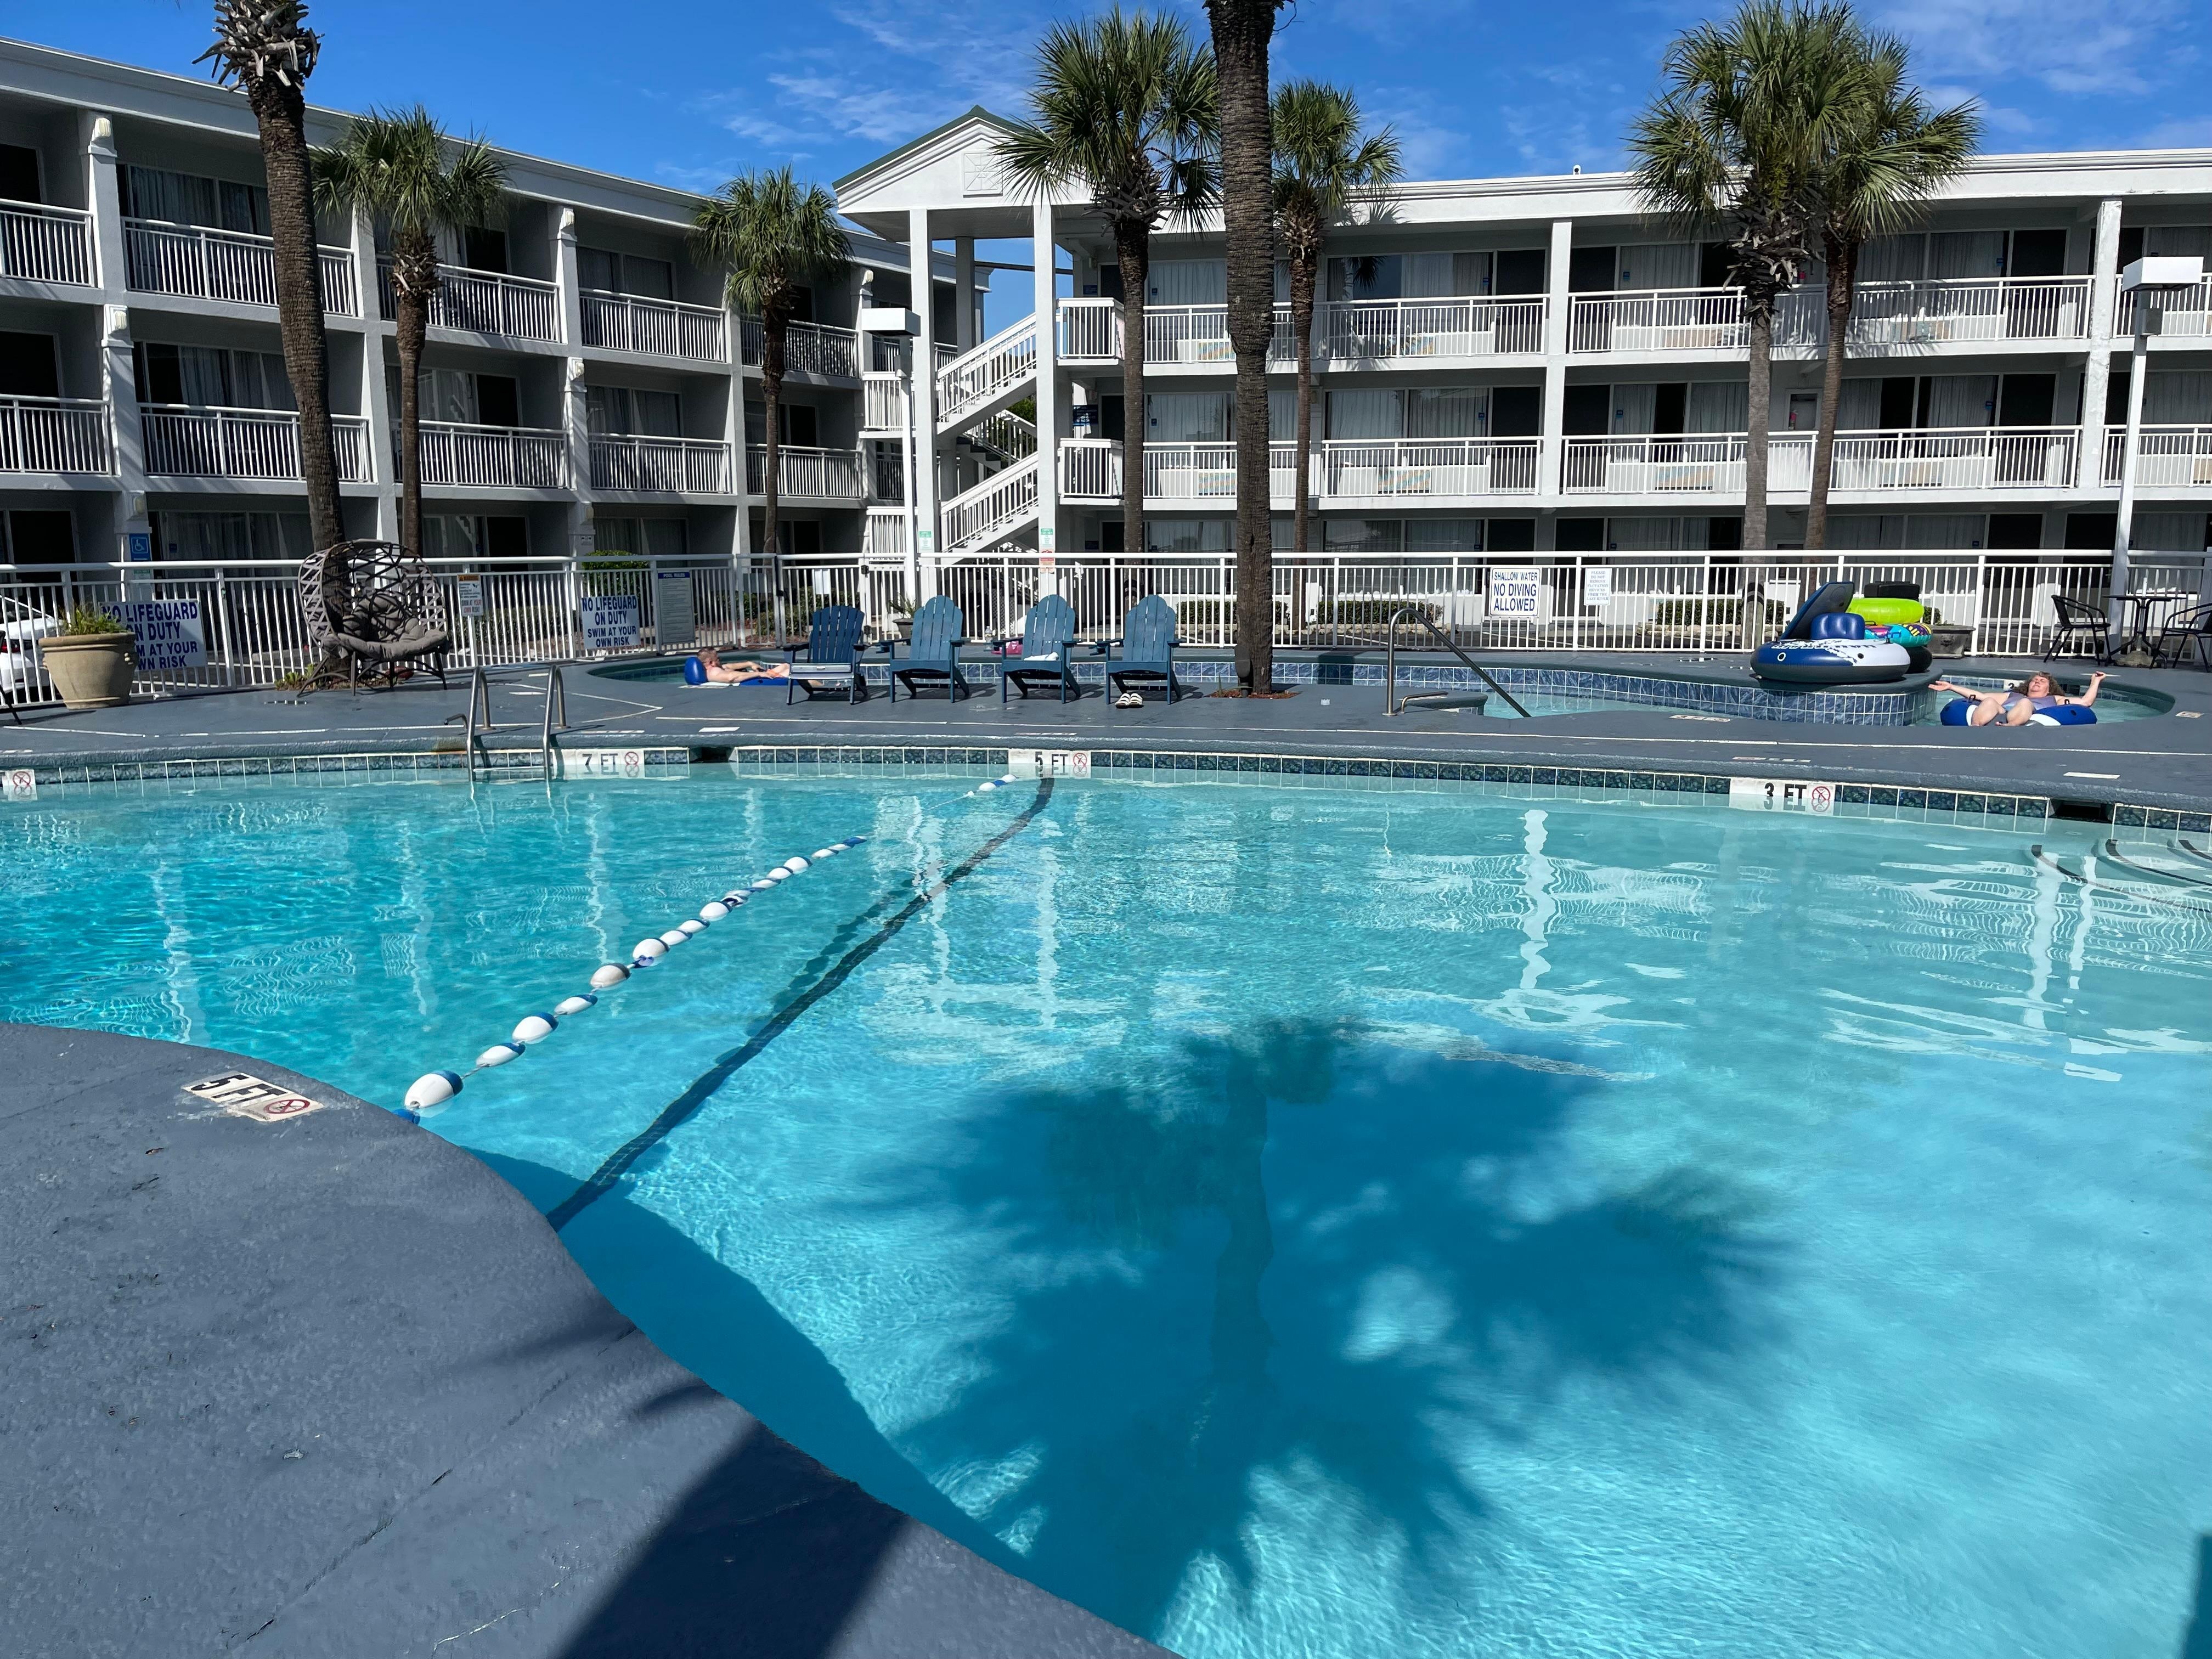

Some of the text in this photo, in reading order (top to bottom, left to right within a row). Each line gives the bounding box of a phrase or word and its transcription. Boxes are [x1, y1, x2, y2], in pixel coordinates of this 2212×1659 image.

[1494, 572, 1538, 581] SHALLOW WATER
[1494, 583, 1537, 596] NO DIVING
[582, 596, 637, 612] NO LIFEGUARD
[1494, 597, 1535, 611] ALLOWED
[125, 602, 198, 622] LIFEGUARD
[595, 611, 627, 625] ON DUTY
[148, 622, 180, 641] DUTY
[588, 625, 636, 637] SWIM AT YOUR
[149, 643, 163, 656] AT
[166, 641, 198, 654] YOUR
[596, 636, 630, 647] OWN RISK
[138, 655, 187, 670] WN RISK
[582, 753, 618, 766] 7 FT
[1035, 751, 1069, 766] 5 FT
[1764, 782, 1807, 799] 3 FT
[190, 1074, 289, 1106] 5 FT
